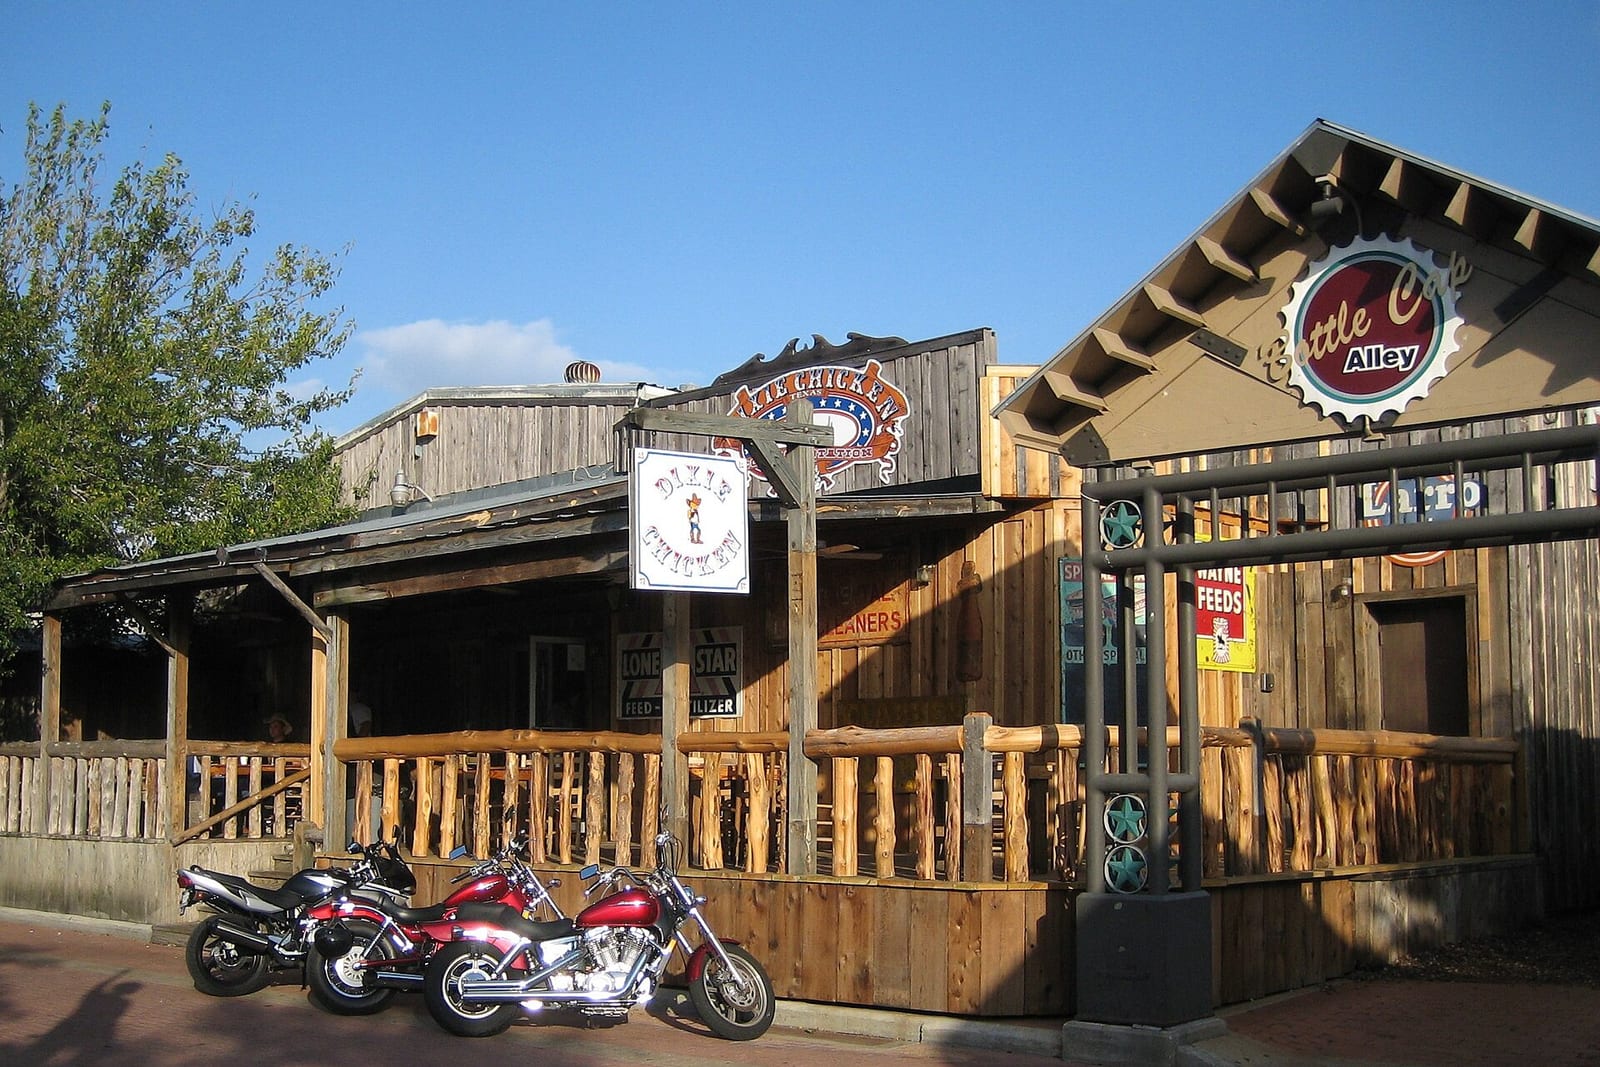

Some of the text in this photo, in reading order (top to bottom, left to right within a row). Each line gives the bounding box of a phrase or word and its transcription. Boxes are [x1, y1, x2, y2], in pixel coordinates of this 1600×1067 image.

[1258, 250, 1473, 381] Bottle Cap
[1345, 344, 1419, 372] Alley
[737, 368, 899, 421] IXIE CHICKEN
[788, 390, 823, 401] TEXAS
[655, 465, 732, 505] DIXIE
[641, 525, 743, 578] CHICKEN
[1197, 566, 1242, 585] WAYNE
[1197, 585, 1242, 615] FEEDS
[623, 646, 736, 677] LONE STAR
[626, 701, 653, 715] FEED
[691, 697, 734, 714] ILIZER
